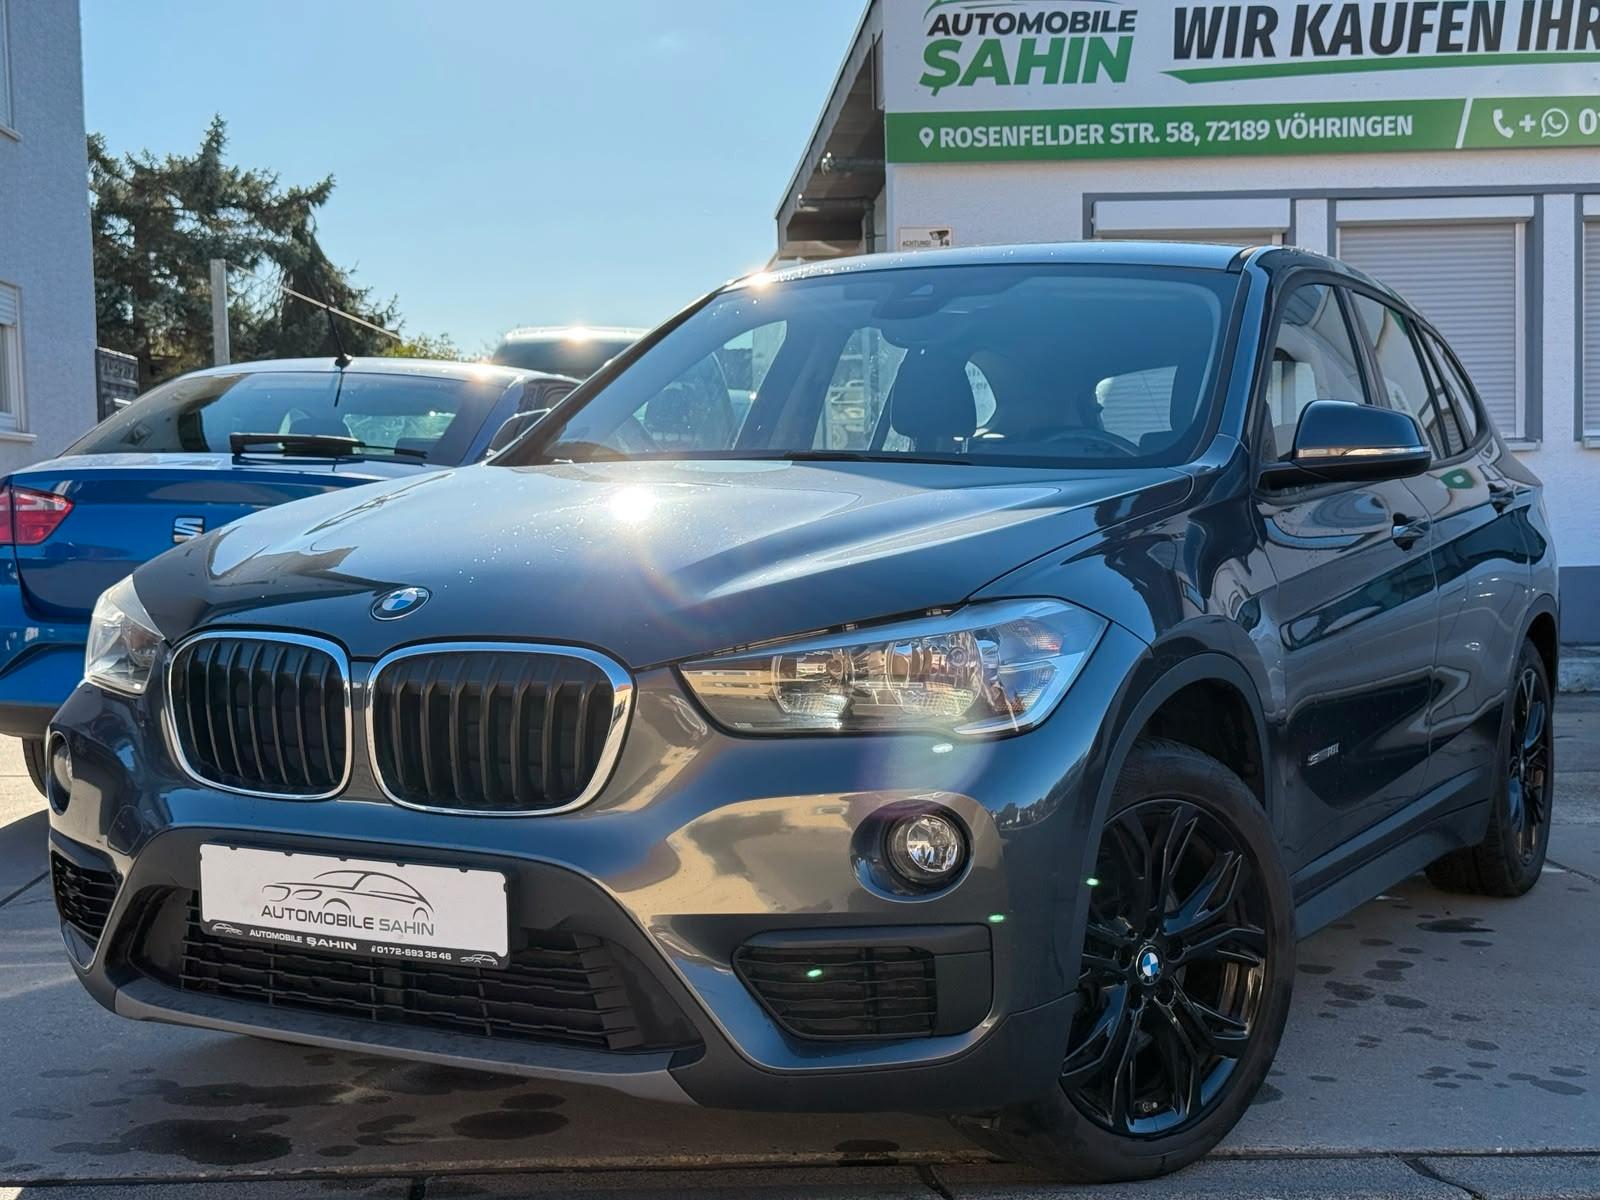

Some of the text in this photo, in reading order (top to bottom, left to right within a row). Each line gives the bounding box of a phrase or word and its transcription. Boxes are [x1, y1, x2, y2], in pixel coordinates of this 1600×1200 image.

[927, 9, 1138, 36] AUTOMOBILE
[1173, 5, 1279, 60] WIR
[1290, 1, 1506, 57] KAUFEN
[919, 35, 1134, 97] ŞAHIN
[940, 112, 1413, 148] ROSENFELDER STR. 58, 72189 VÖHRINGEN
[1579, 108, 1600, 135] 0
[261, 904, 435, 936] AUTOMOBILE SAHIN
[249, 929, 303, 943] AUTOMOBILE
[306, 936, 358, 951] ŞAHIN
